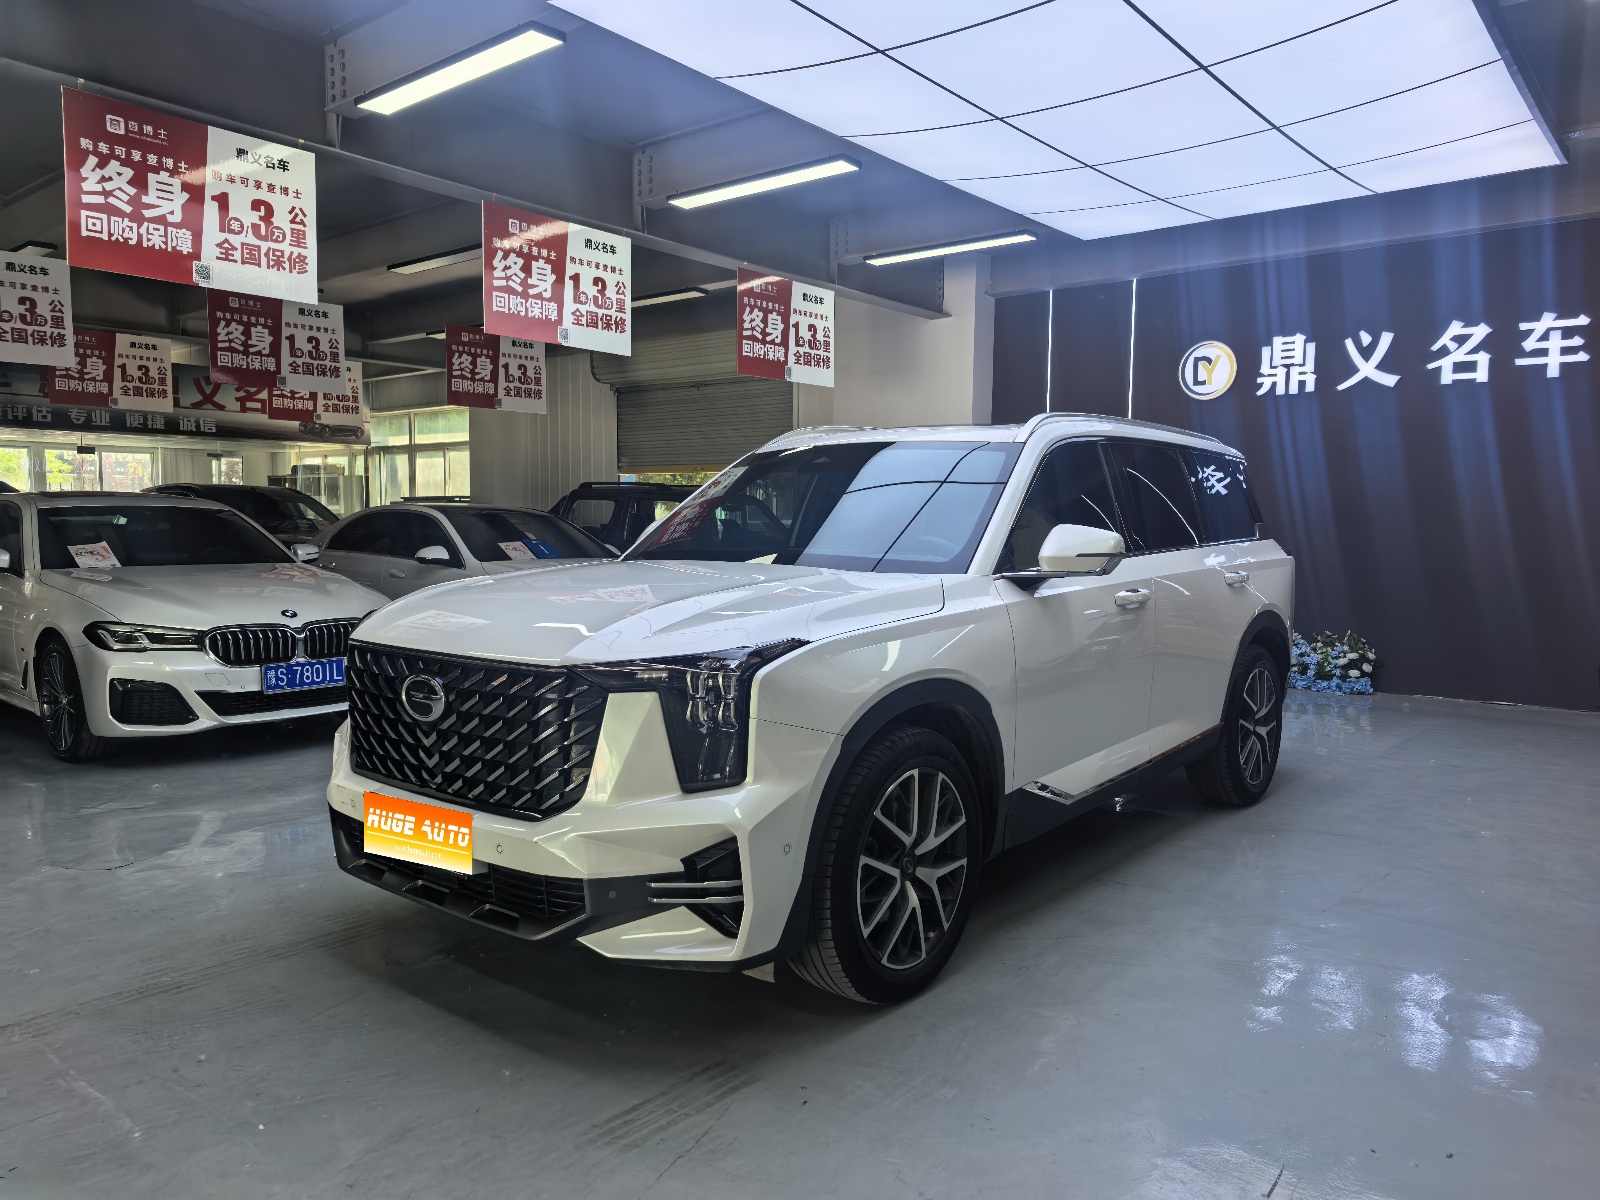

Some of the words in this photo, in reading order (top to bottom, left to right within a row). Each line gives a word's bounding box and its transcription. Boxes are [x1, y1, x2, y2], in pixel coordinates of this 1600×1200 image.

[80, 137, 189, 173] 购车可享查博士
[235, 147, 290, 172] 鼎义名车
[80, 154, 190, 222] 终身
[211, 169, 302, 200] 购车可享查博士
[80, 209, 193, 254] 回购保障
[215, 238, 309, 275] 全国保修
[492, 237, 557, 260] 购车可享查博士
[584, 238, 617, 255] 鼎义名车
[5, 262, 50, 276] 鼎义名车
[492, 250, 556, 298] 终身
[569, 256, 624, 276] 购车可享查博士
[492, 291, 558, 322] 回购保障
[216, 311, 273, 326] 购车可享查博士
[284, 321, 337, 334] 购车可享查博士
[571, 308, 627, 334] 全国保修
[743, 306, 784, 343] 终身
[216, 320, 273, 355] 终身
[217, 351, 277, 372] 回购保障
[742, 340, 785, 362] 回购保障
[793, 350, 831, 369] 全国保修
[1256, 311, 1592, 396] 鼎义名车
[288, 360, 341, 379] 全国保修
[452, 352, 493, 381] 终身
[55, 377, 109, 394] 回购保障
[120, 385, 169, 399] 全国保修
[451, 379, 495, 395] 回购保障
[503, 385, 543, 400] 全国保修
[272, 397, 314, 411] 回购保障
[322, 402, 360, 415] 全国保修
[0, 403, 52, 422] 评估
[68, 408, 110, 427] 专业
[126, 412, 165, 430] 便捷
[179, 416, 217, 433] 诚信
